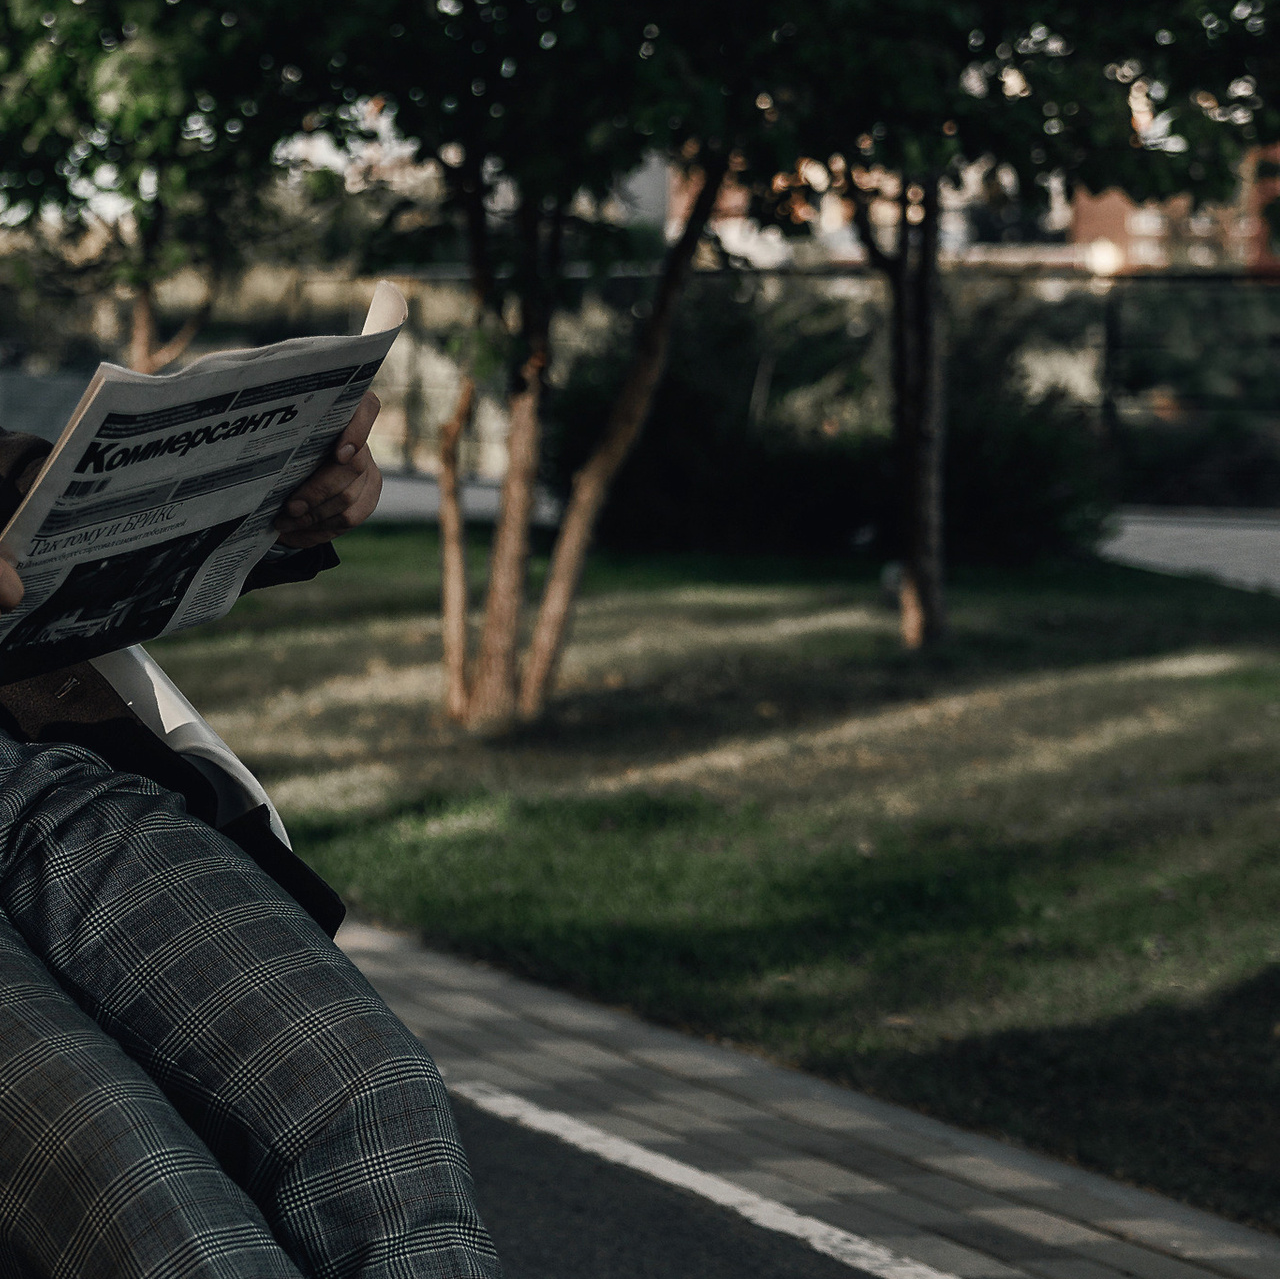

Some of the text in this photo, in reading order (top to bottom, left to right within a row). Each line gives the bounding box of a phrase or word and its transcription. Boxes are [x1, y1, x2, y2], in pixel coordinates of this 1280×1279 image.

[73, 404, 299, 474] Коммерсантъ
[26, 538, 63, 557] Так
[62, 526, 108, 549] тому
[105, 523, 122, 537] и
[121, 502, 184, 533] БРИКС
